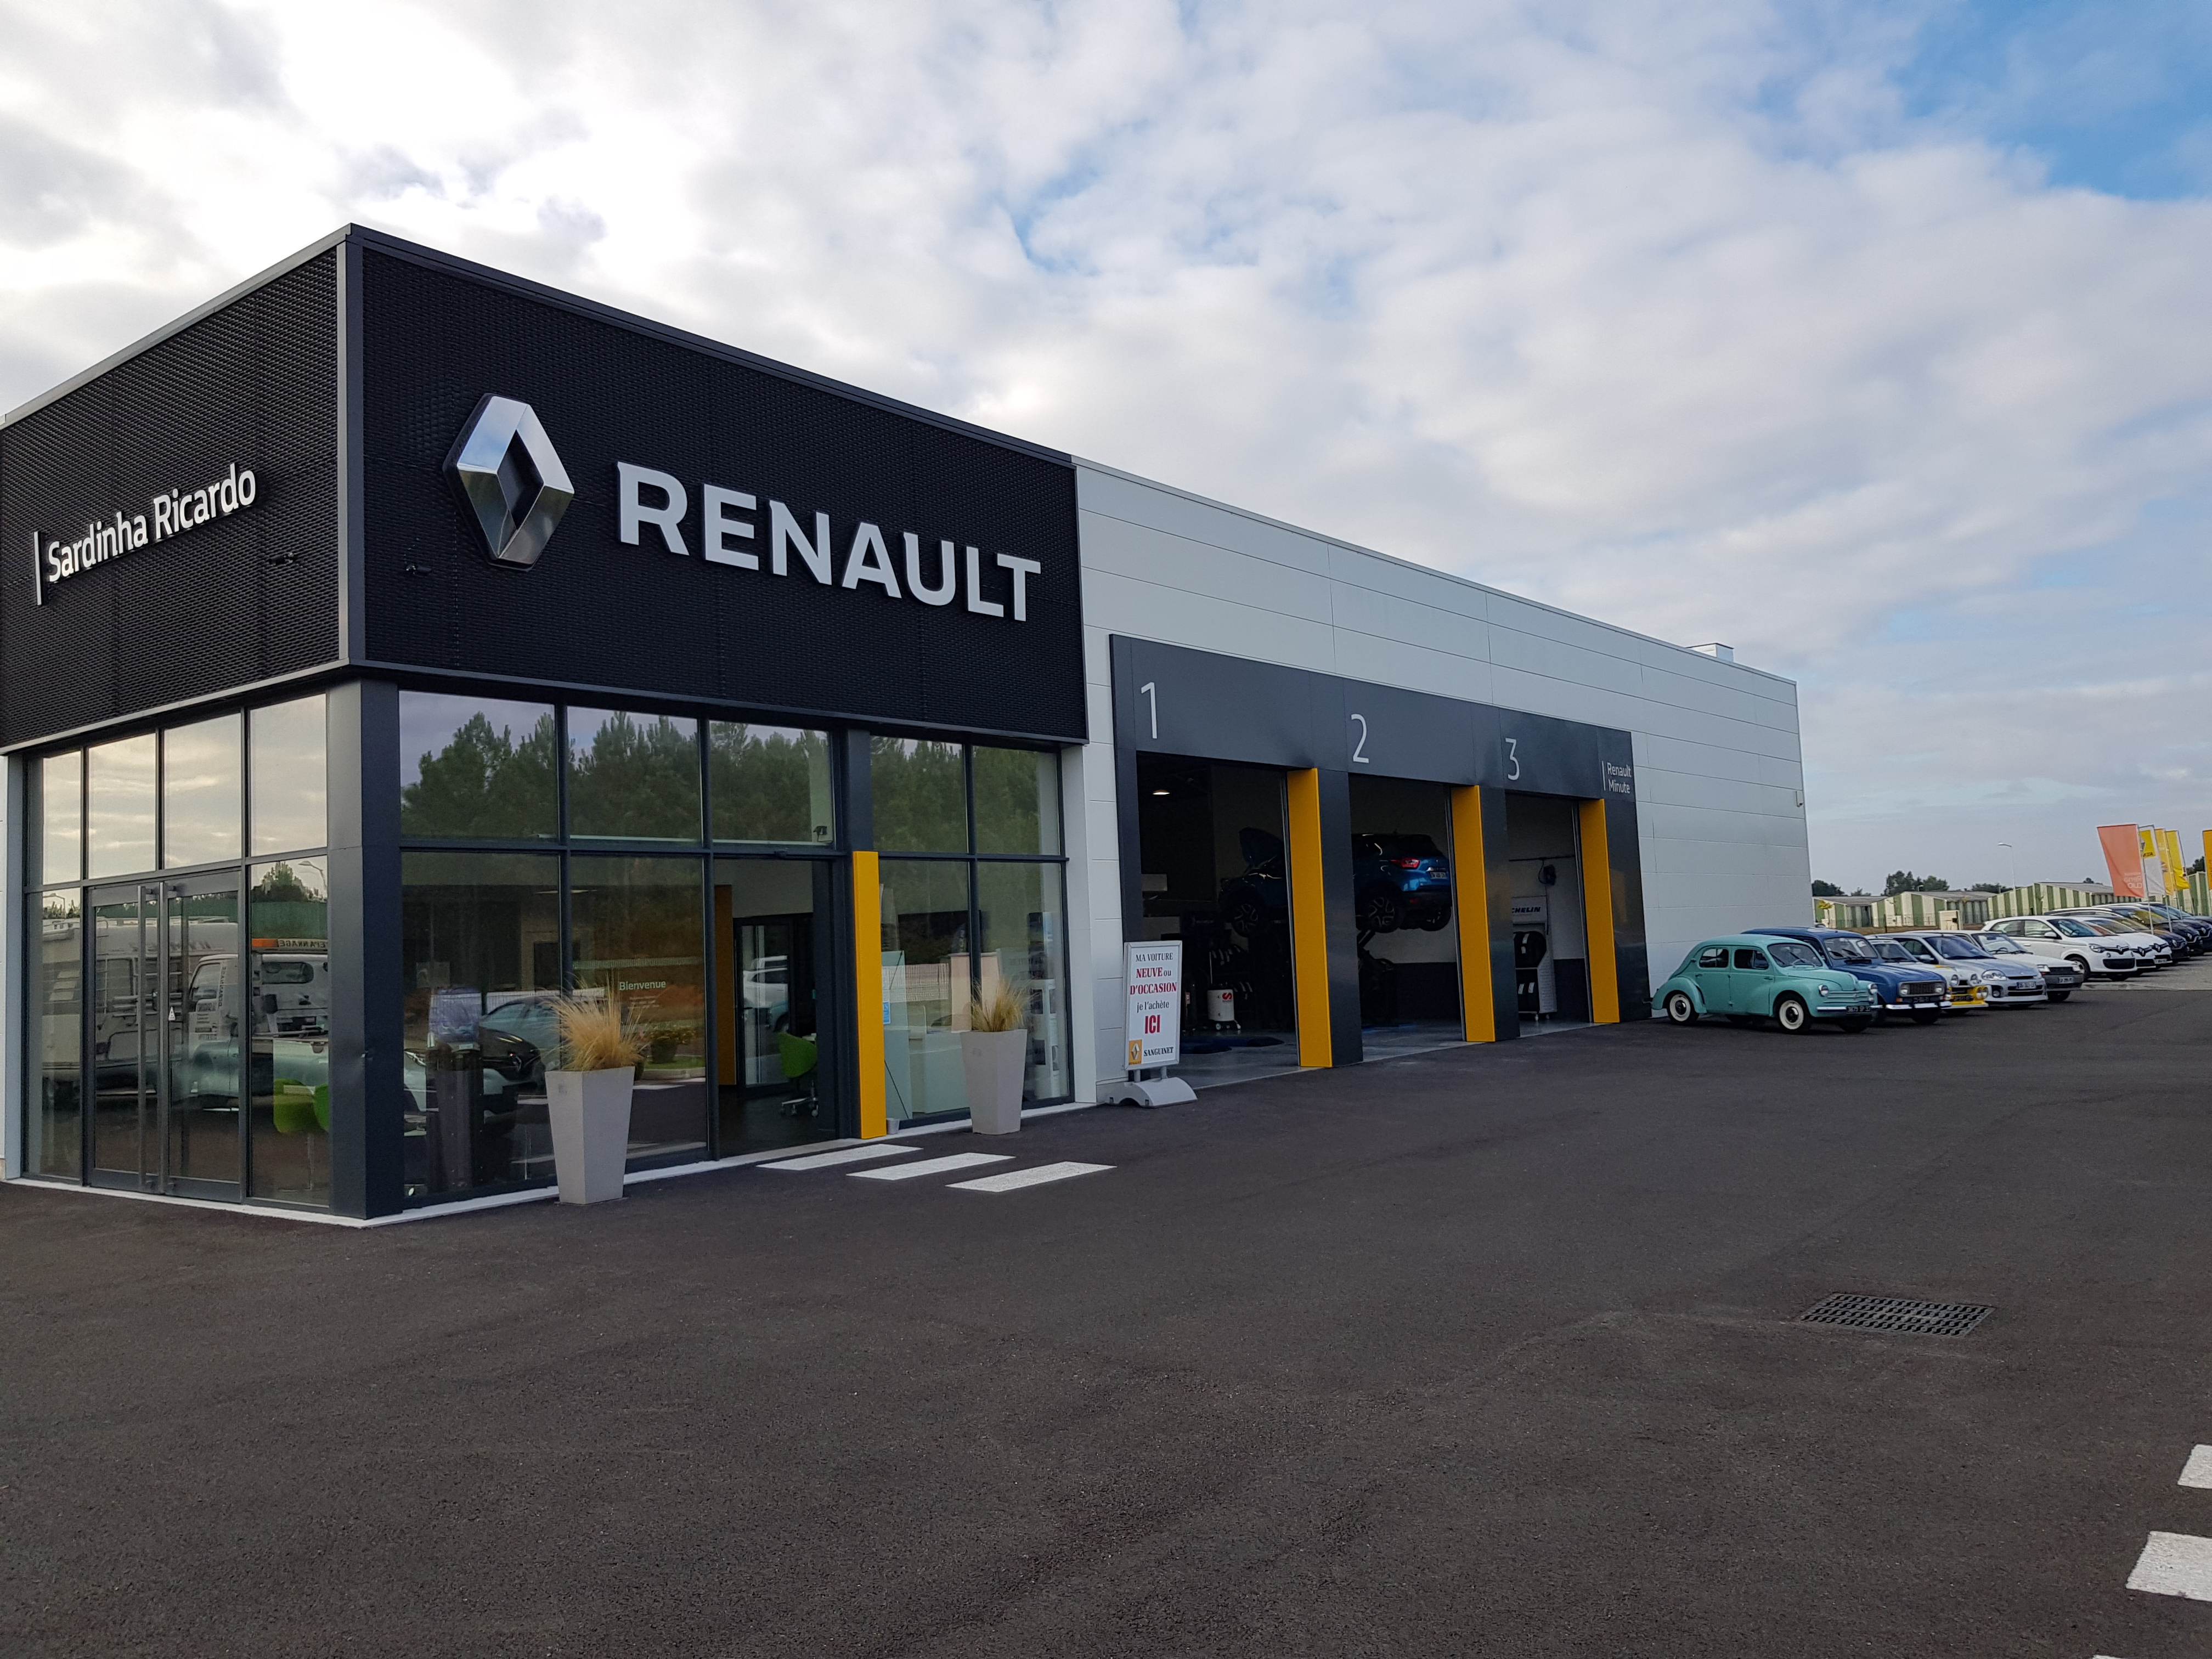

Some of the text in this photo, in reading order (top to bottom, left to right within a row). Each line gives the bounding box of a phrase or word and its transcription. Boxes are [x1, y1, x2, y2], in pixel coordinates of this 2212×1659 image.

[48, 462, 256, 582] Sardinha Ricardo
[617, 461, 1041, 622] RENAULT
[1141, 682, 1157, 739] 1
[1351, 714, 1369, 763] 2
[1505, 737, 1520, 780] 3
[1607, 762, 1632, 777] Renault
[1608, 779, 1630, 794] Minute
[1136, 952, 1173, 962] MA VOITURE
[1136, 967, 1163, 978] NEUVE
[619, 981, 666, 991] Bienvenue
[1130, 982, 1177, 995] D'OCCASION
[1137, 1000, 1170, 1013] je l'achète
[1144, 1014, 1160, 1034] ICI
[1143, 1047, 1173, 1057] SANGUINET
